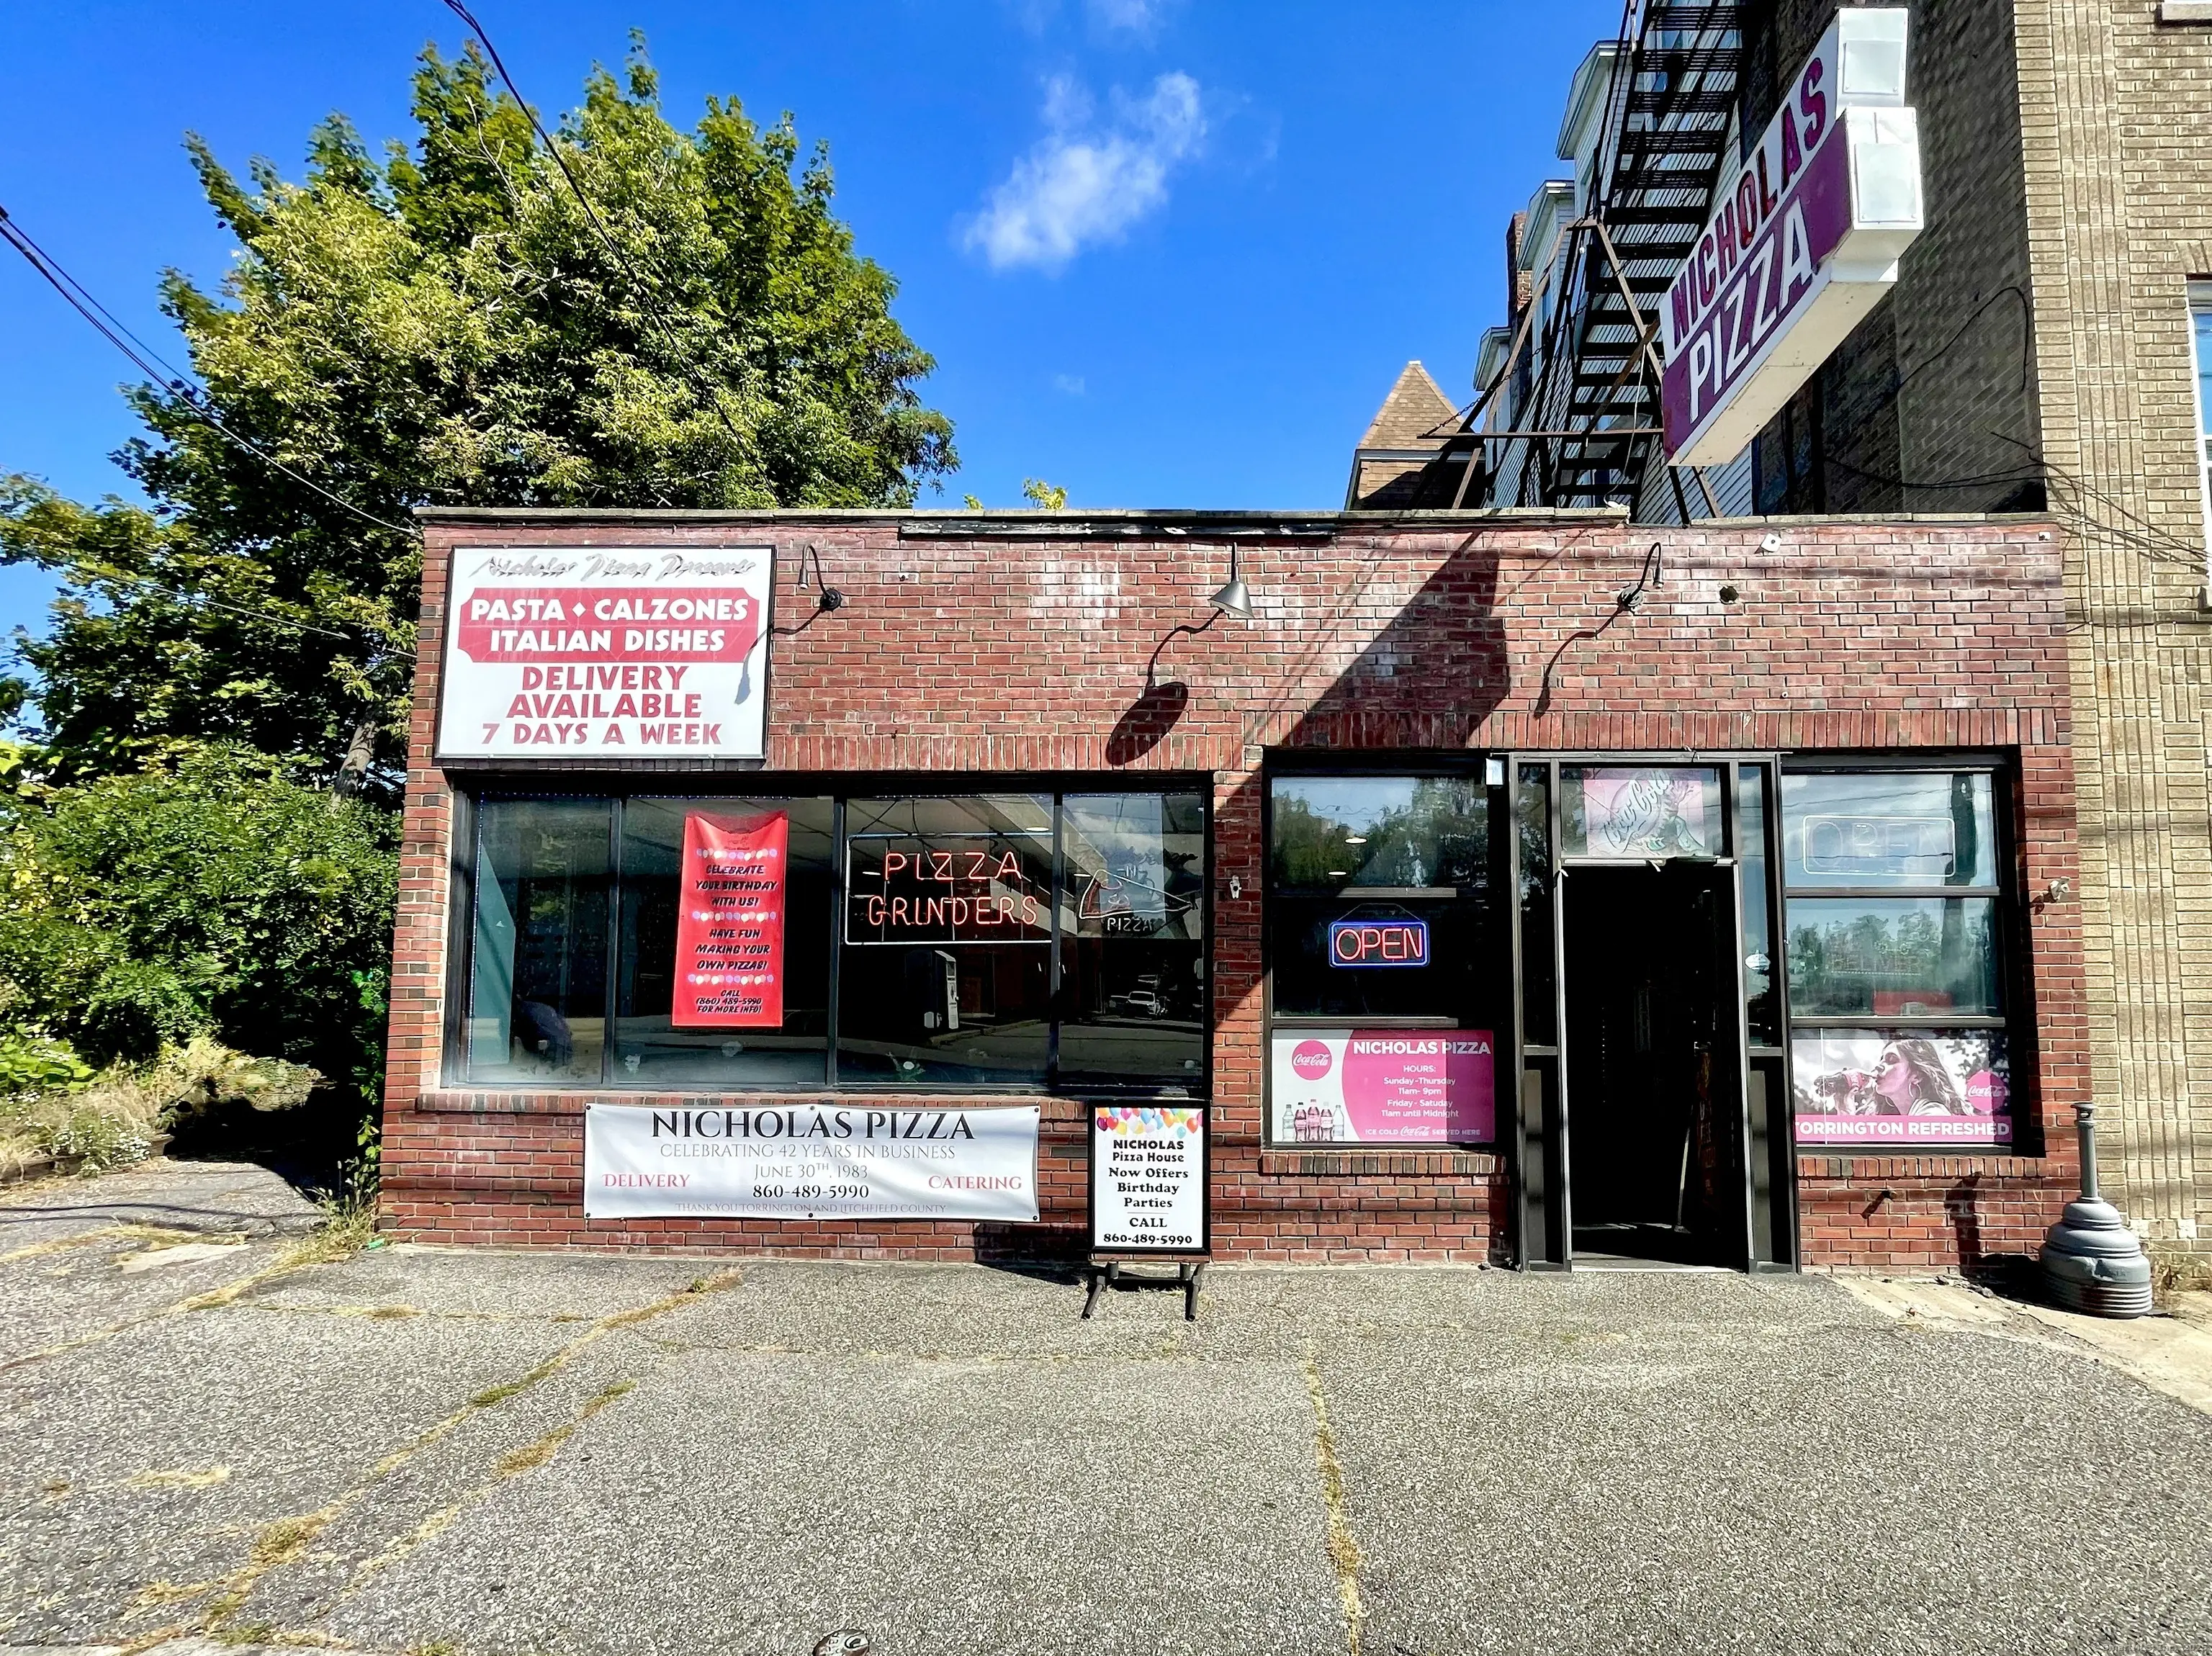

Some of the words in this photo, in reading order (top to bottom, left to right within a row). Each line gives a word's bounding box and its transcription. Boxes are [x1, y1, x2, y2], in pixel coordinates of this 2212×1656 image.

[1671, 57, 1827, 346] NICHOLAS
[1689, 195, 1814, 425] PIZZA
[470, 598, 565, 621] PASTA
[594, 598, 749, 621] CALZONES
[490, 629, 611, 652] ITALIAN
[624, 629, 725, 652] DISHES
[522, 665, 689, 690] DELIVERY
[506, 693, 702, 719] AVAILABLE
[481, 723, 500, 744] 7
[513, 723, 588, 744] DAYS
[602, 723, 625, 744] A
[640, 723, 722, 744] WEEK
[706, 865, 765, 875] CELEBRATE
[885, 851, 1022, 881] PIZZA
[696, 880, 720, 890] YOUR
[721, 881, 777, 891] BIRTHDAY
[739, 897, 759, 906] US!
[868, 894, 1038, 926] GRINDERS
[1107, 917, 1153, 932] PIZZA
[709, 929, 736, 939] HAVE
[738, 929, 760, 939] FUN
[696, 944, 740, 955] MAKING
[743, 944, 770, 955] YOUR
[1336, 928, 1422, 960] OPEN
[697, 960, 725, 970] OWN
[727, 960, 768, 970] PIZZAS!
[1353, 1041, 1439, 1055] NICHOLAS
[1442, 1042, 1491, 1055] PIZZA
[1423, 1087, 1442, 1096] 9pm
[1423, 1110, 1459, 1118] Midnight
[651, 1110, 853, 1140] NICHOLAS
[866, 1110, 975, 1140] PIZZA
[1795, 1122, 1904, 1135] ORRINGTON
[1908, 1122, 2010, 1135] REFRESHED
[660, 1143, 774, 1158] CELEBRATING
[779, 1144, 796, 1158] 42
[801, 1144, 852, 1158] YEARS
[857, 1145, 876, 1158] IN
[881, 1145, 956, 1159] BUSINESS
[1113, 1140, 1184, 1150] NICHOLAS
[1112, 1152, 1143, 1161] Pizza
[1148, 1152, 1184, 1162] House
[755, 1164, 793, 1181] JUNE
[837, 1164, 868, 1179] 1983
[1109, 1167, 1141, 1177] Now
[1146, 1168, 1188, 1178] Offers
[602, 1174, 690, 1188] DELIVERY
[928, 1175, 1022, 1189] CATERING
[1118, 1182, 1179, 1194] Birthday
[752, 1184, 869, 1199] 860-489-5990
[675, 1203, 712, 1212] THANK
[715, 1203, 737, 1212] YOU
[738, 1203, 811, 1212] TORRINGTON
[814, 1204, 837, 1212] AND
[900, 1205, 946, 1213] COUNTY
[1124, 1197, 1173, 1207] Parties
[1129, 1218, 1167, 1228] CALL
[1103, 1233, 1192, 1245] 860-489-5990
